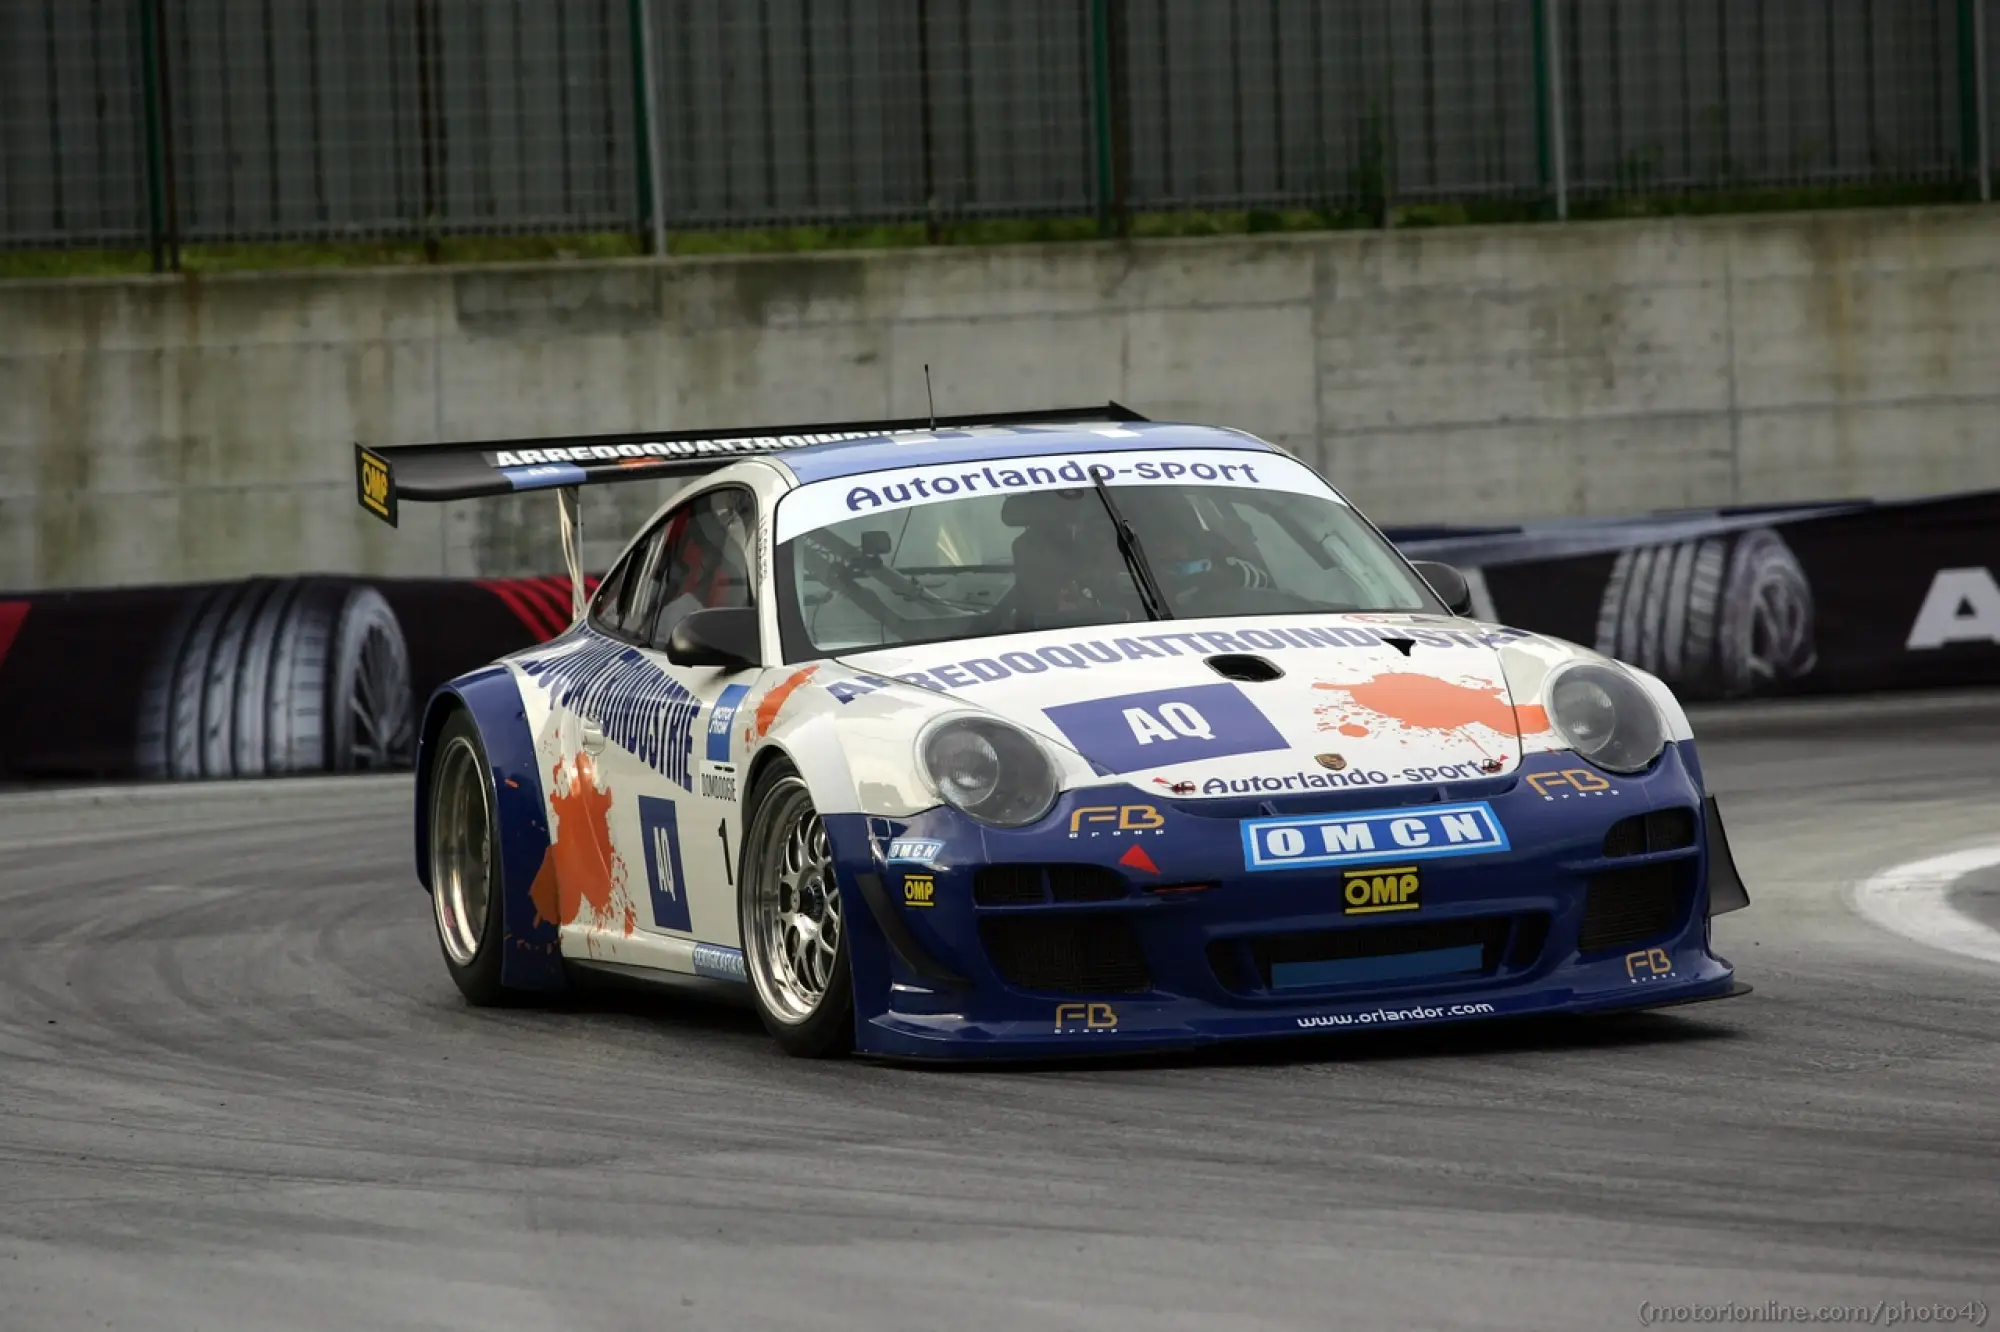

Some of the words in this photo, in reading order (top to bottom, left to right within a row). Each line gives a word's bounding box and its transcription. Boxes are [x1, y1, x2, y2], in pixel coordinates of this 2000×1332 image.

[362, 461, 388, 504] OMP
[846, 459, 1260, 511] Autorlando-sport
[1121, 702, 1217, 746] AQ
[1203, 759, 1487, 795] Autorlando-sport
[1526, 769, 1610, 796] FB
[1070, 805, 1165, 831] FB
[1266, 812, 1485, 857] OMCN
[718, 817, 734, 886] 1
[889, 844, 937, 859] OMCN
[904, 880, 934, 900] OMP
[1344, 873, 1420, 906] OMP
[1625, 948, 1671, 978] FB
[1055, 1003, 1118, 1028] FB
[1297, 1003, 1495, 1028] www.orlandor.com
